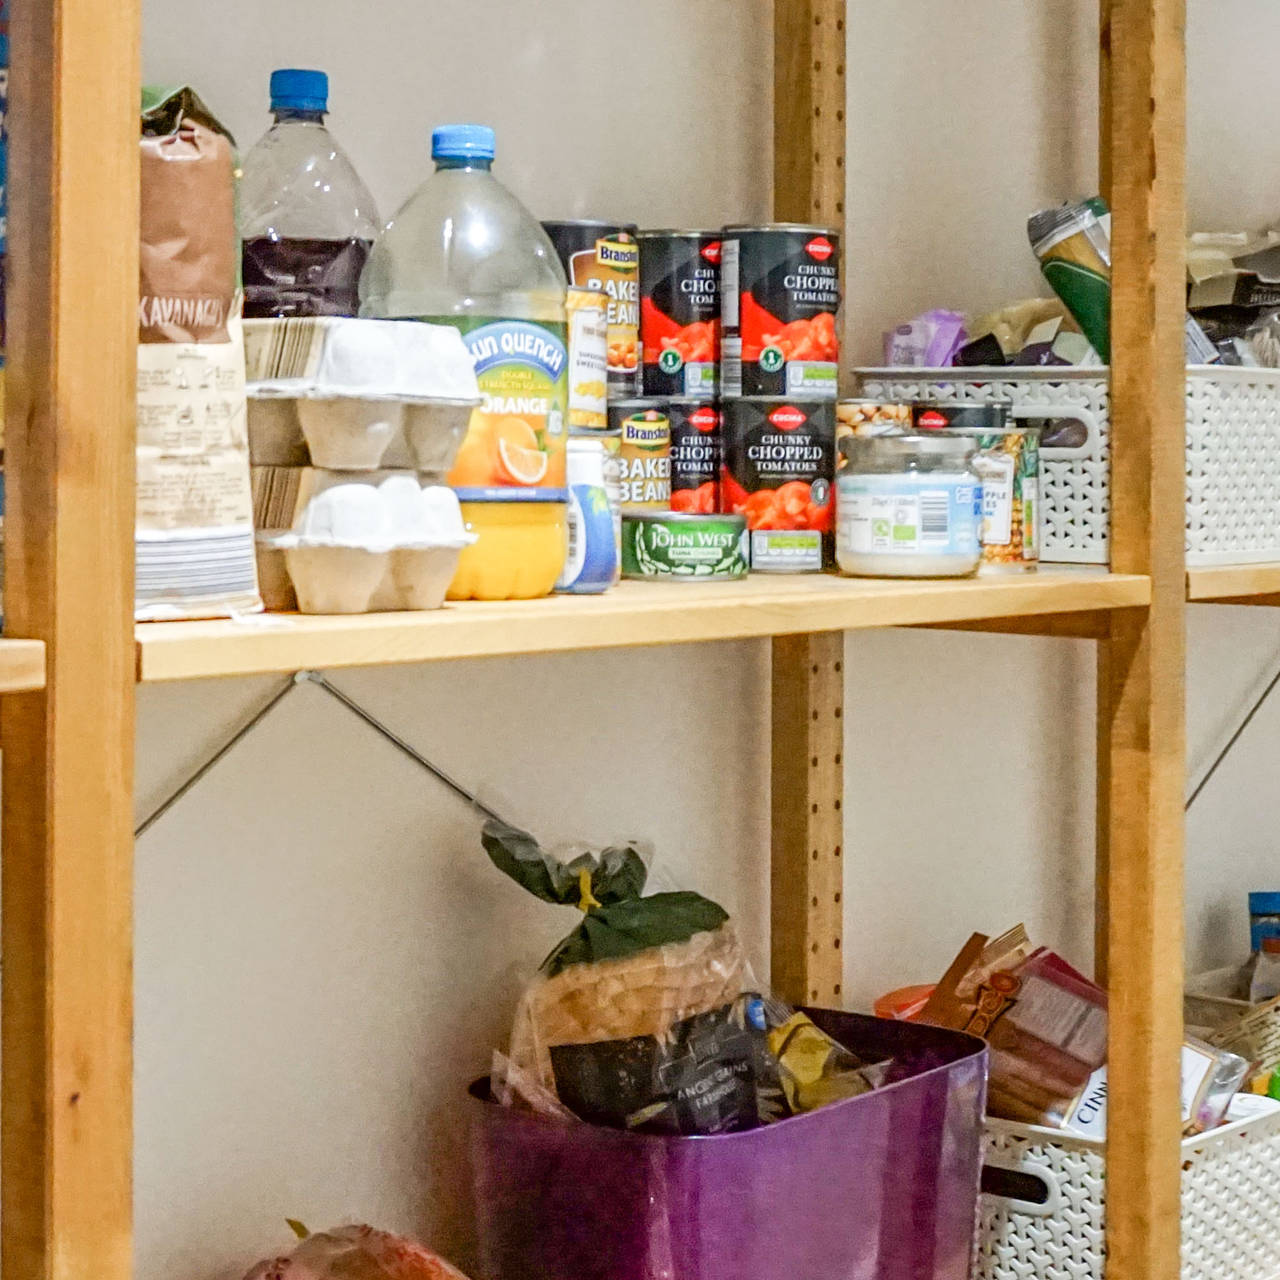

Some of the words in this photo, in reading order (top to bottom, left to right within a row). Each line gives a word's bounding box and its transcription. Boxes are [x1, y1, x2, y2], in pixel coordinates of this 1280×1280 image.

[587, 278, 637, 300] BAKE
[680, 279, 716, 294] CHO
[688, 294, 714, 304] TOM
[501, 332, 563, 372] QUENCH
[480, 396, 548, 415] ORANGE
[761, 435, 811, 446] CHUNKY
[748, 446, 823, 460] CHOPPED
[675, 461, 714, 472] TOMAT
[756, 461, 817, 472] TOMATOES
[619, 479, 670, 502] BEAN
[984, 491, 1007, 499] PPLE
[651, 531, 694, 550] JOHN
[696, 532, 734, 548] WEST
[1077, 1080, 1107, 1125] CINN
